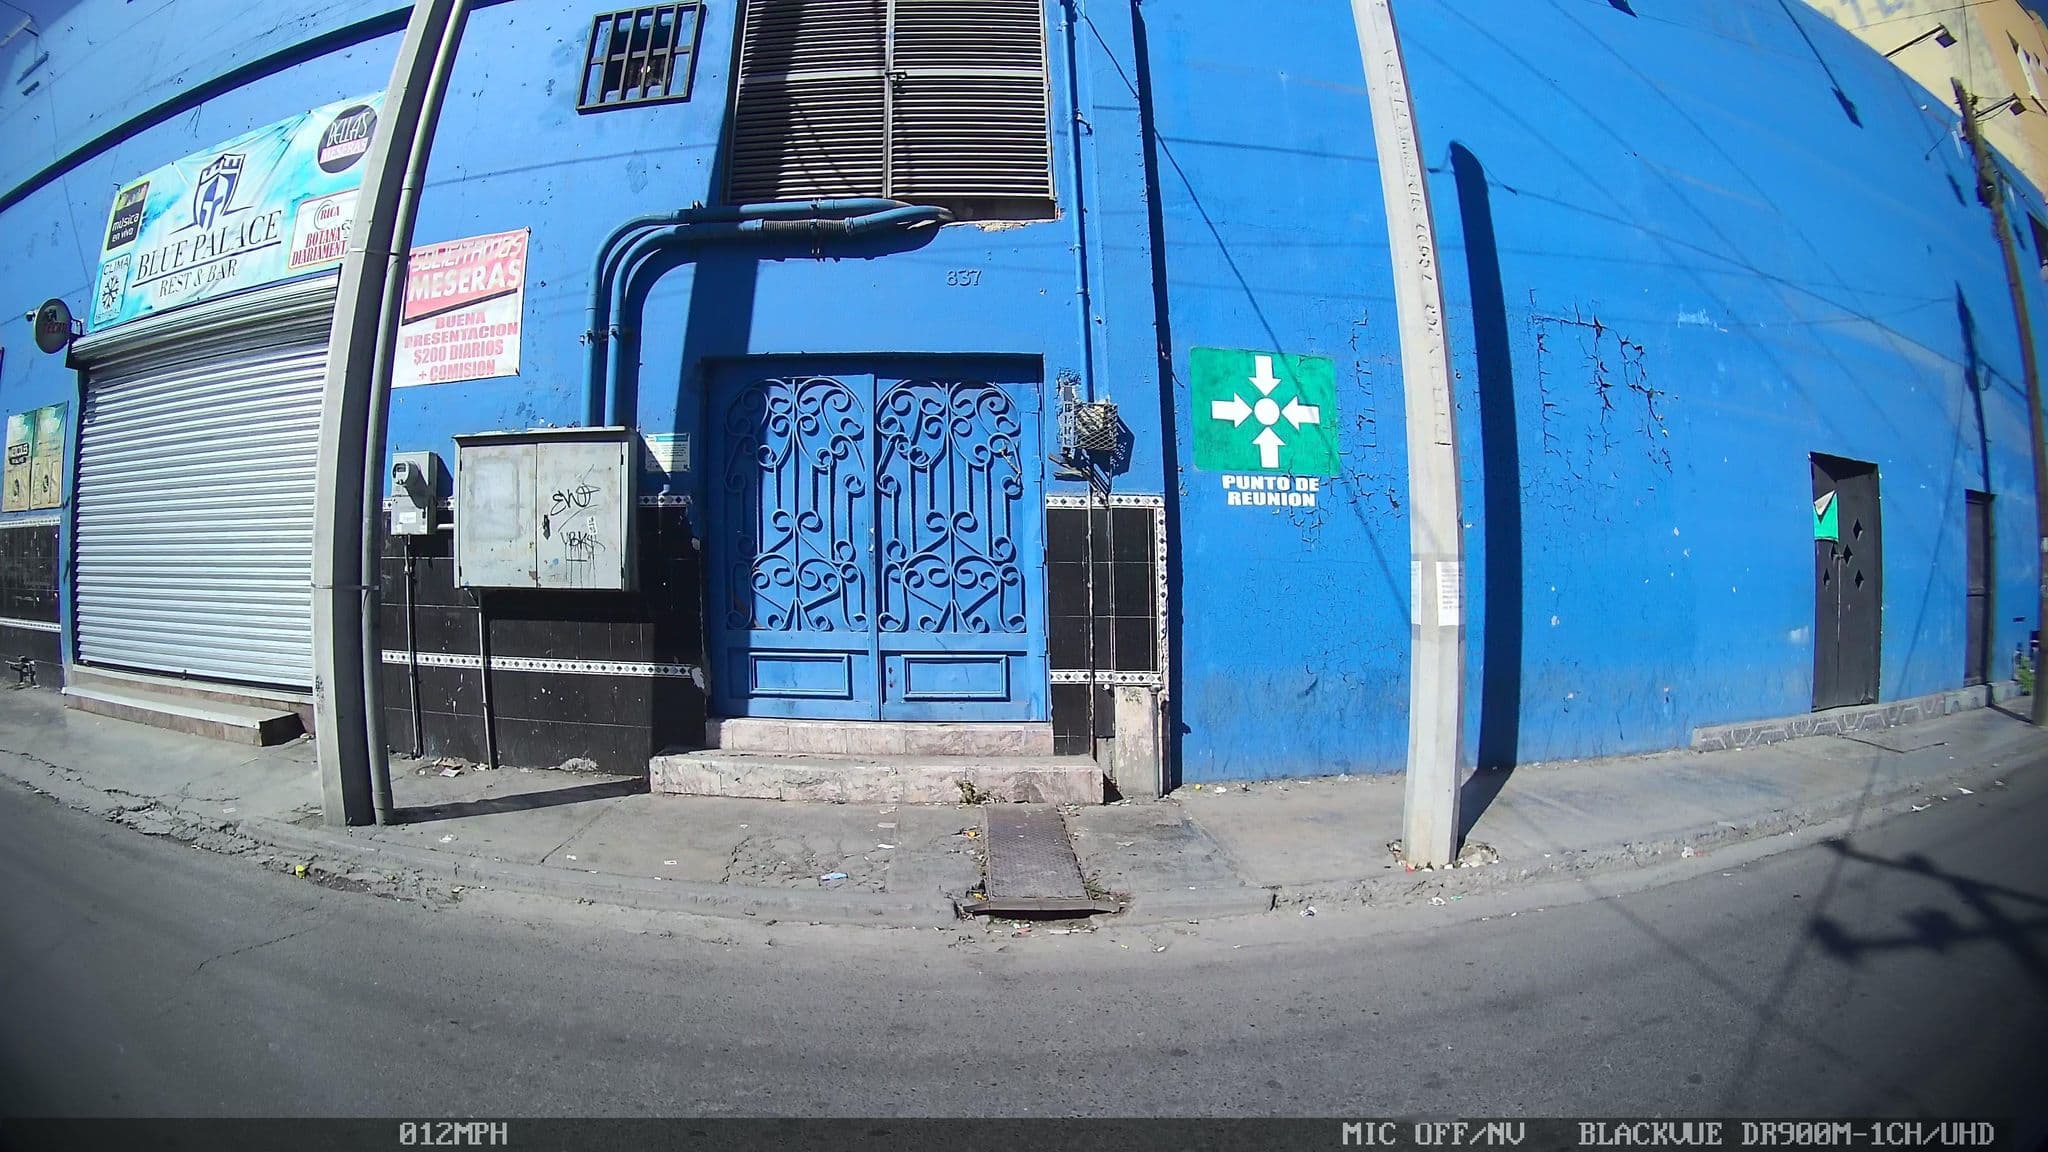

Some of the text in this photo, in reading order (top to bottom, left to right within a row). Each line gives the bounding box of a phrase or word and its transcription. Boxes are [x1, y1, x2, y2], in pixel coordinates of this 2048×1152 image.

[327, 111, 370, 147] BELLAS
[320, 206, 339, 220] RICA
[136, 210, 282, 281] BLUE PALACE
[305, 226, 341, 248] BOTANA
[291, 240, 349, 266] DIARIAMENT
[103, 257, 129, 275] CLIMA
[160, 258, 237, 297] REST & BAR
[409, 259, 522, 301] MESERAS
[947, 270, 982, 287] 837
[435, 310, 486, 329] BUENA
[404, 322, 518, 348] PRESENTACION
[413, 339, 504, 365] $200 DIARIOS
[418, 359, 496, 382] + COMISION
[1222, 474, 1320, 492] PUNTO DE
[1227, 491, 1316, 507] REUNION
